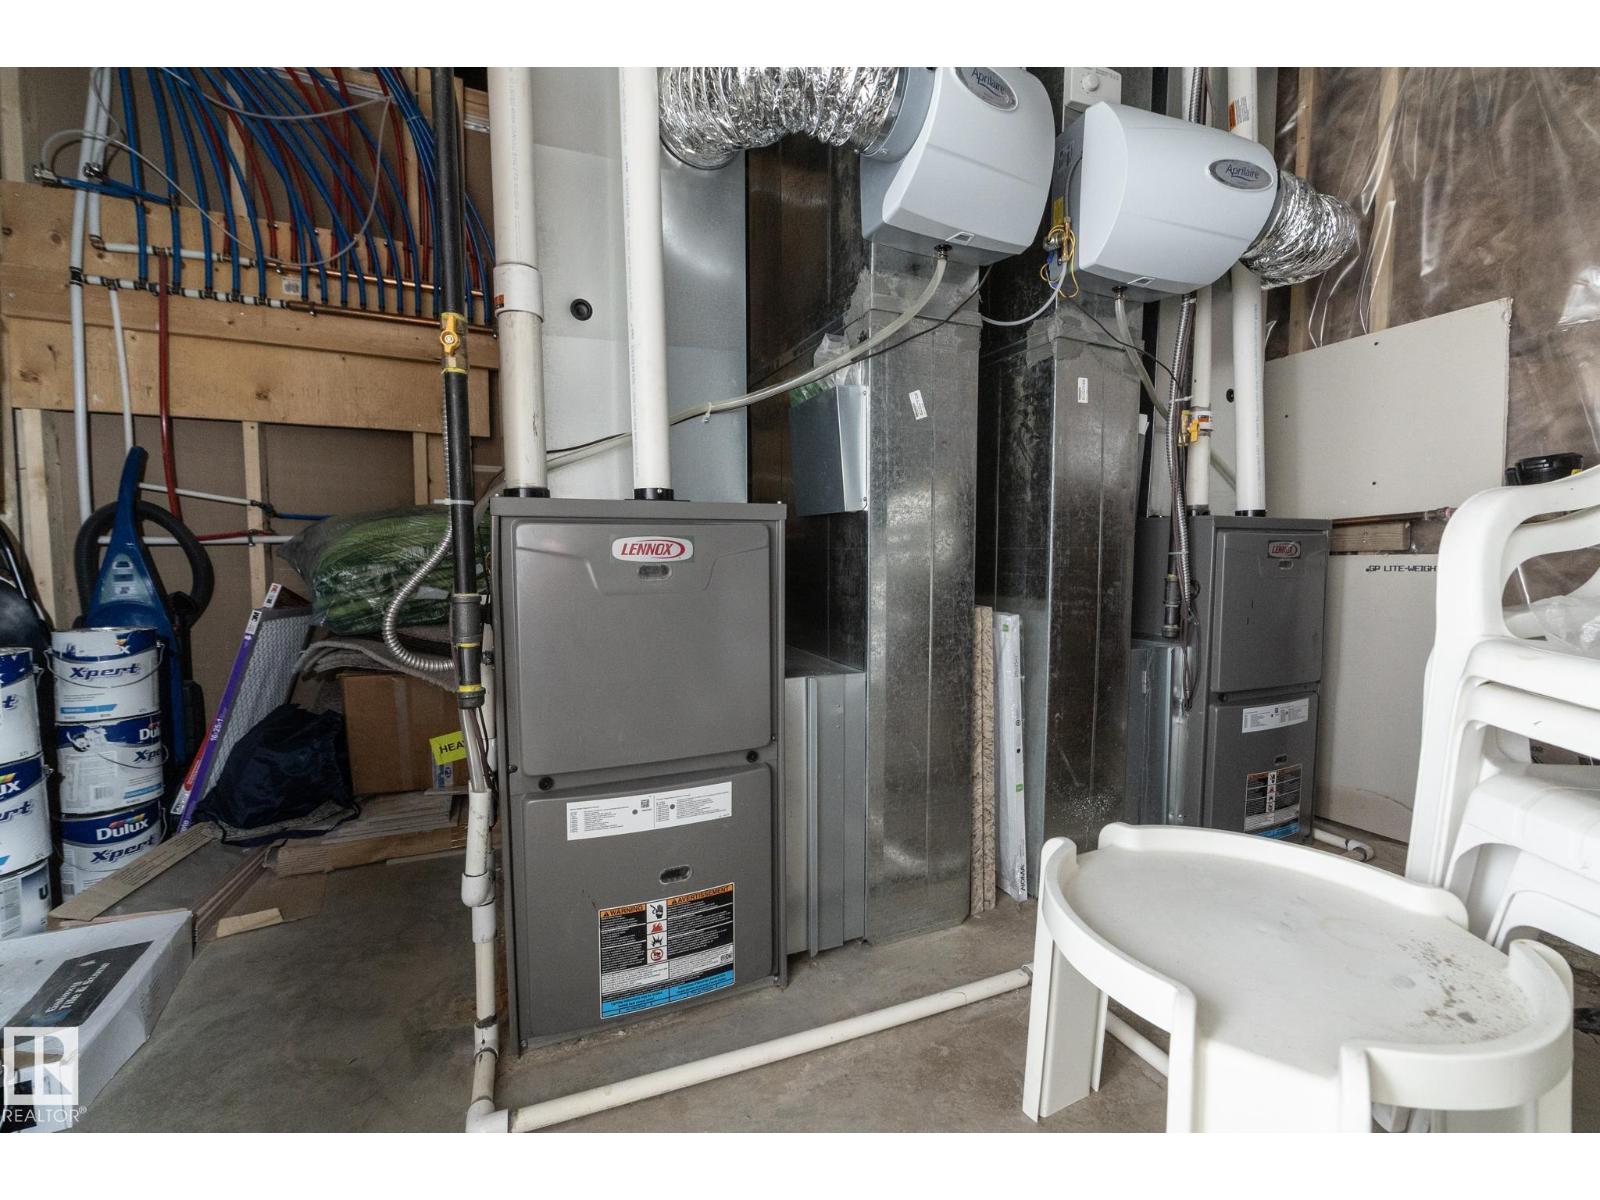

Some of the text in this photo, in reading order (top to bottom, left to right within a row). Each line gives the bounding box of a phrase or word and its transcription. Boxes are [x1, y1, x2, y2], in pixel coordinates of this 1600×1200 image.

[971, 67, 1005, 95] Aprilaire
[1225, 163, 1259, 180] Aprilaire
[621, 543, 673, 555] LENNOX
[96, 819, 148, 841] Dulux
[610, 905, 644, 916] WARNING
